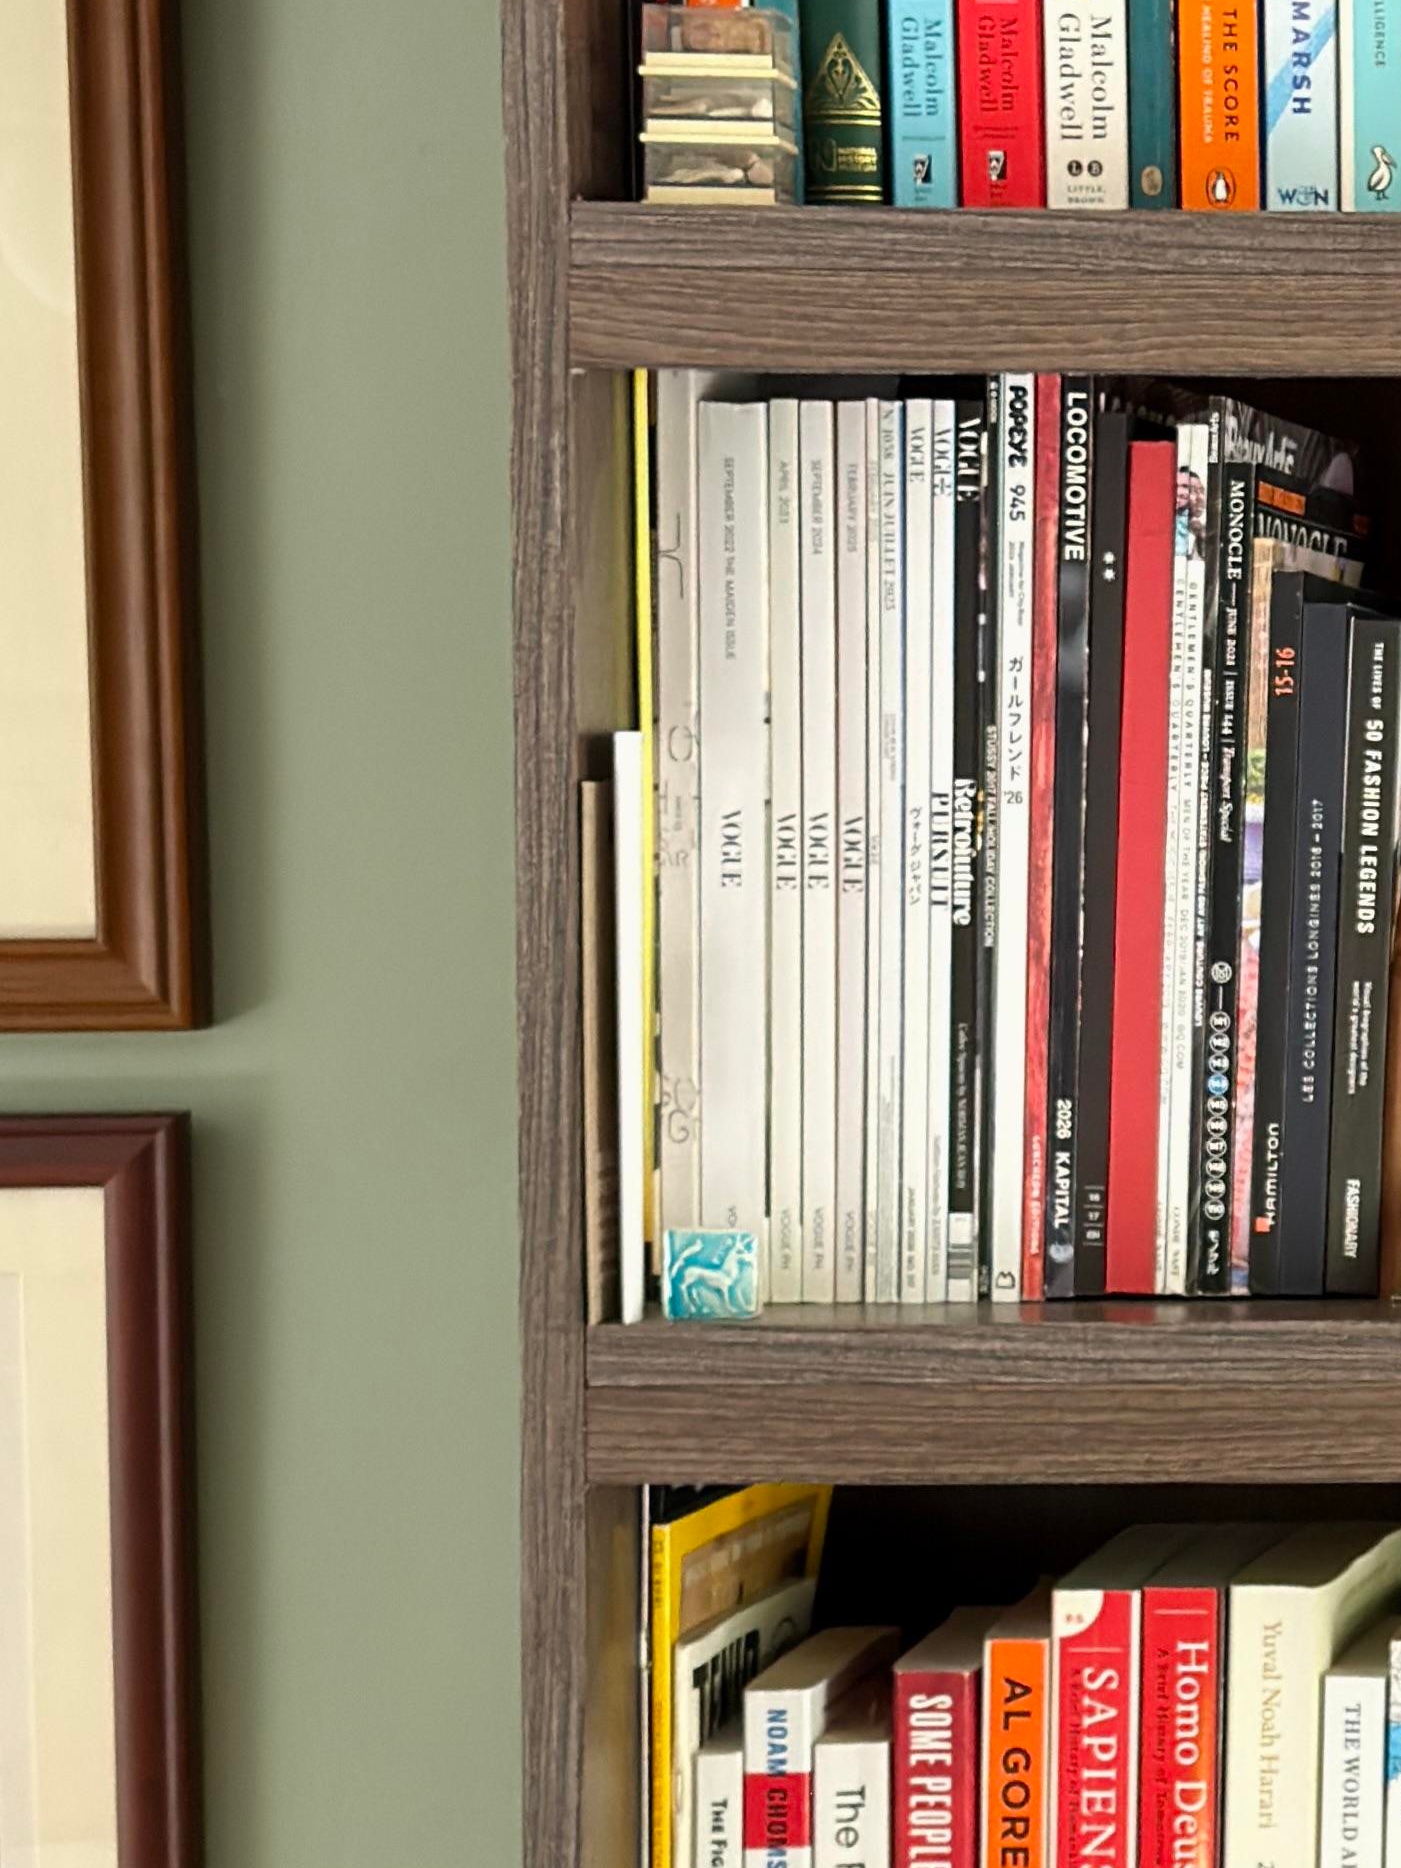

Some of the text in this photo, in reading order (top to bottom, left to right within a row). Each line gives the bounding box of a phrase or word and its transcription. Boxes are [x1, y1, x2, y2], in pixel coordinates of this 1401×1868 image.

[1289, 0, 1312, 115] MARSH
[1064, 391, 1087, 561] LOCOMOTIVE
[1357, 719, 1384, 934] 50 FASHION LEGENDS
[908, 1693, 953, 1766] SOME
[1003, 1677, 1031, 1732] AL
[1174, 1640, 1208, 1768] Homo
[834, 1785, 868, 1848] The
